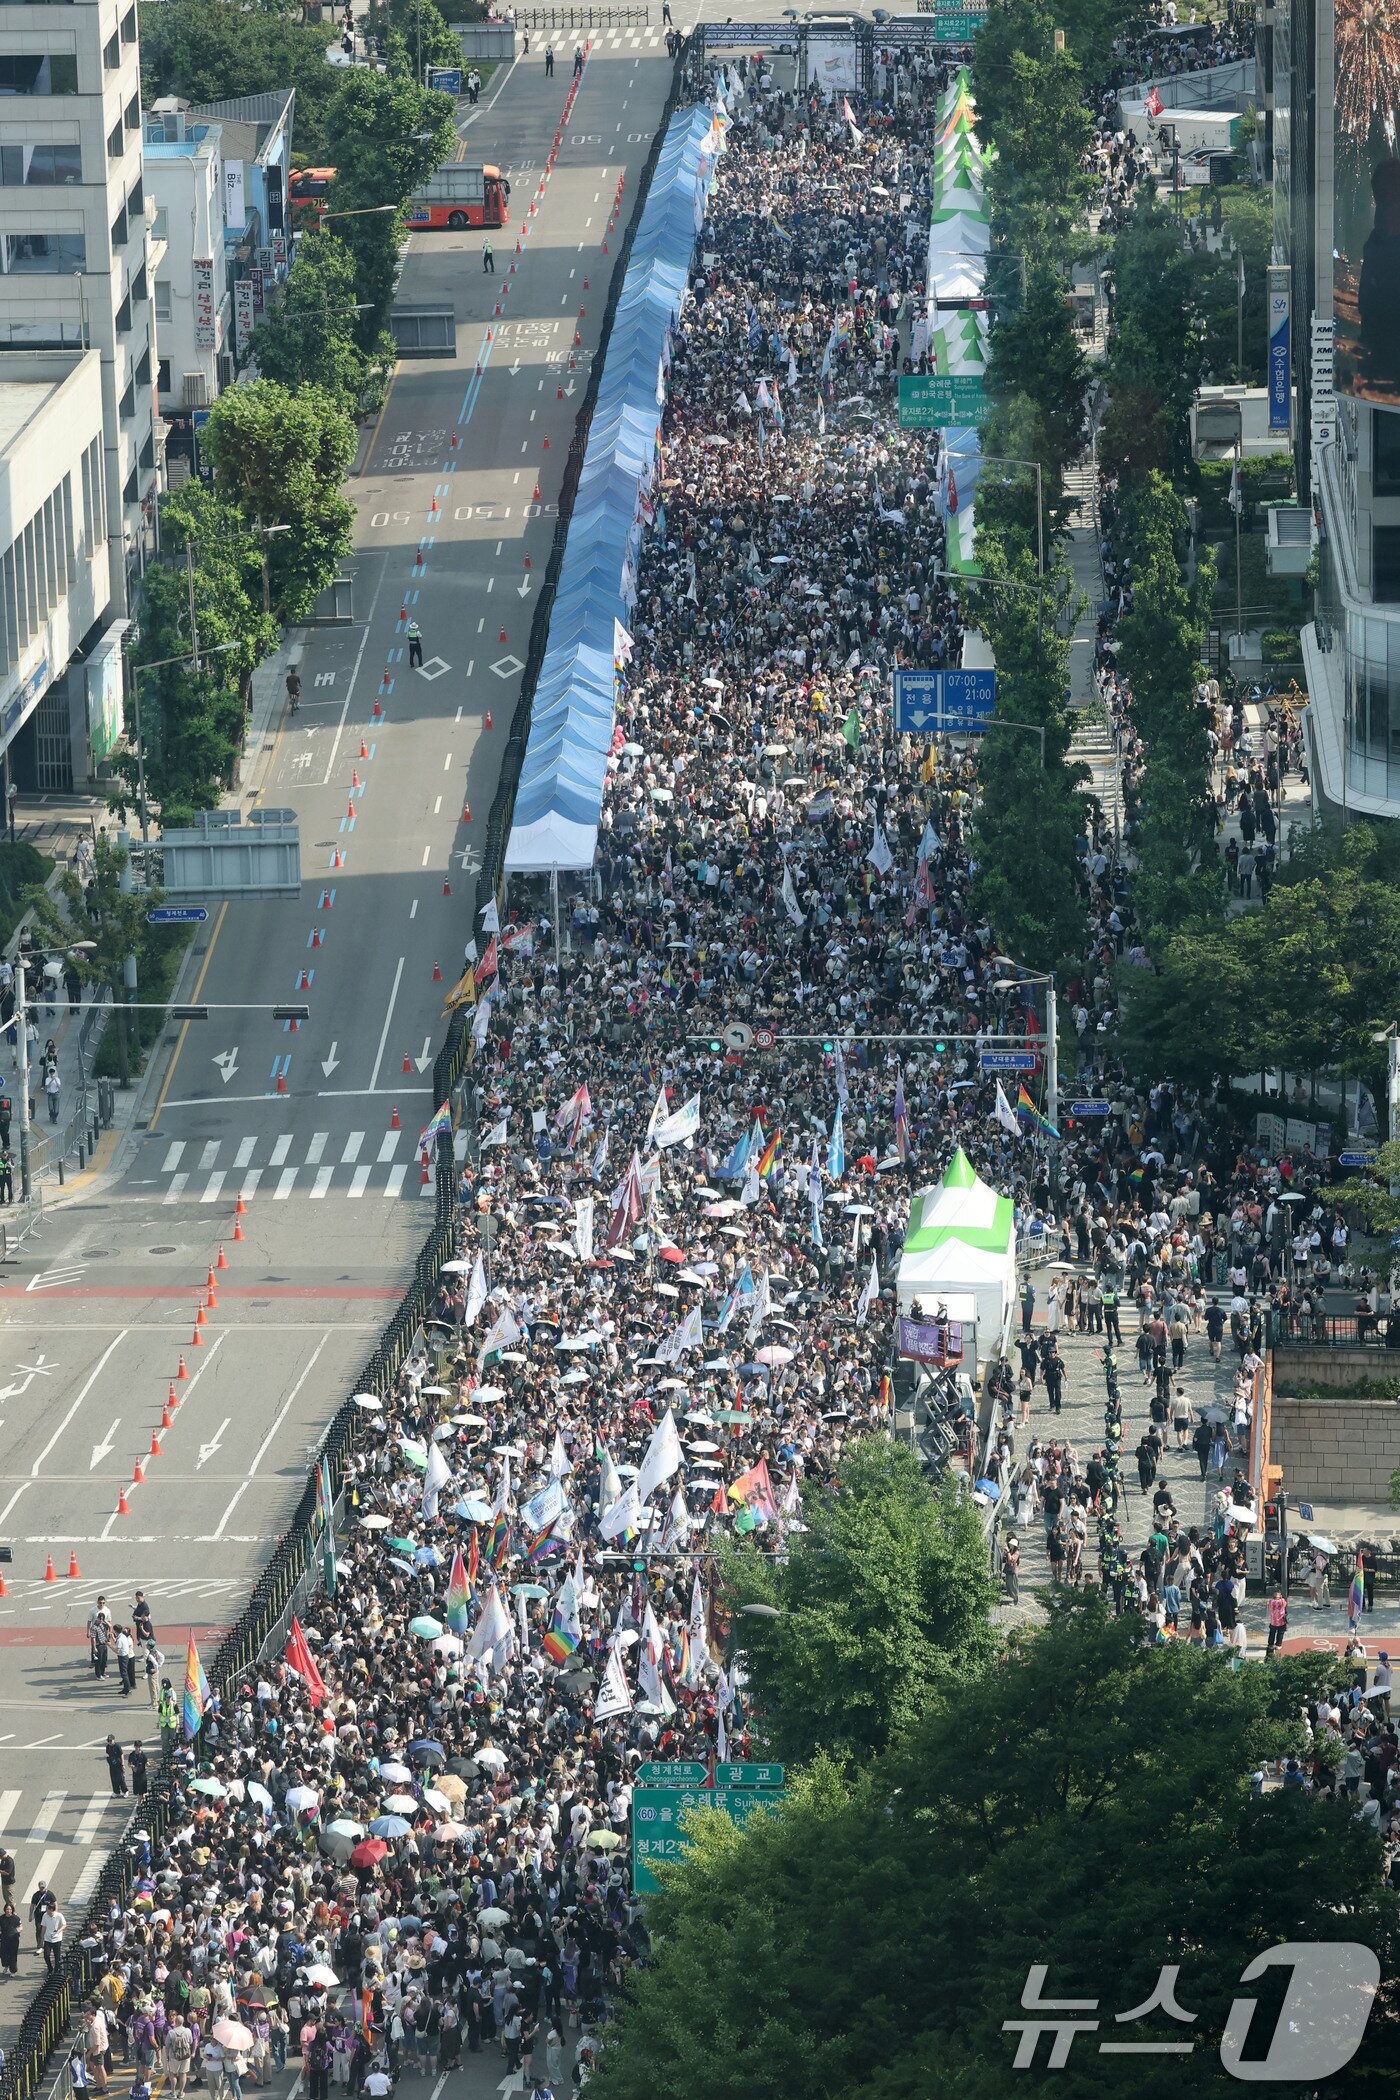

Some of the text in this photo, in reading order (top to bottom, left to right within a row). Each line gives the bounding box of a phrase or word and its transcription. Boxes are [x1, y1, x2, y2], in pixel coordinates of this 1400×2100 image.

[227, 173, 236, 189] Biz
[259, 251, 272, 273] 김밥
[928, 380, 952, 388] 숭례문
[1274, 358, 1285, 404] 수협은행
[921, 390, 952, 399] 한국은행
[902, 407, 934, 416] 을지로2가
[965, 689, 991, 700] 21:00
[758, 1034, 770, 1043] 50
[651, 1765, 693, 1775] 청계천로
[645, 1775, 699, 1784] Cheonggyecheonno
[680, 1792, 728, 1808] 숭례문
[641, 1809, 654, 1819] 60
